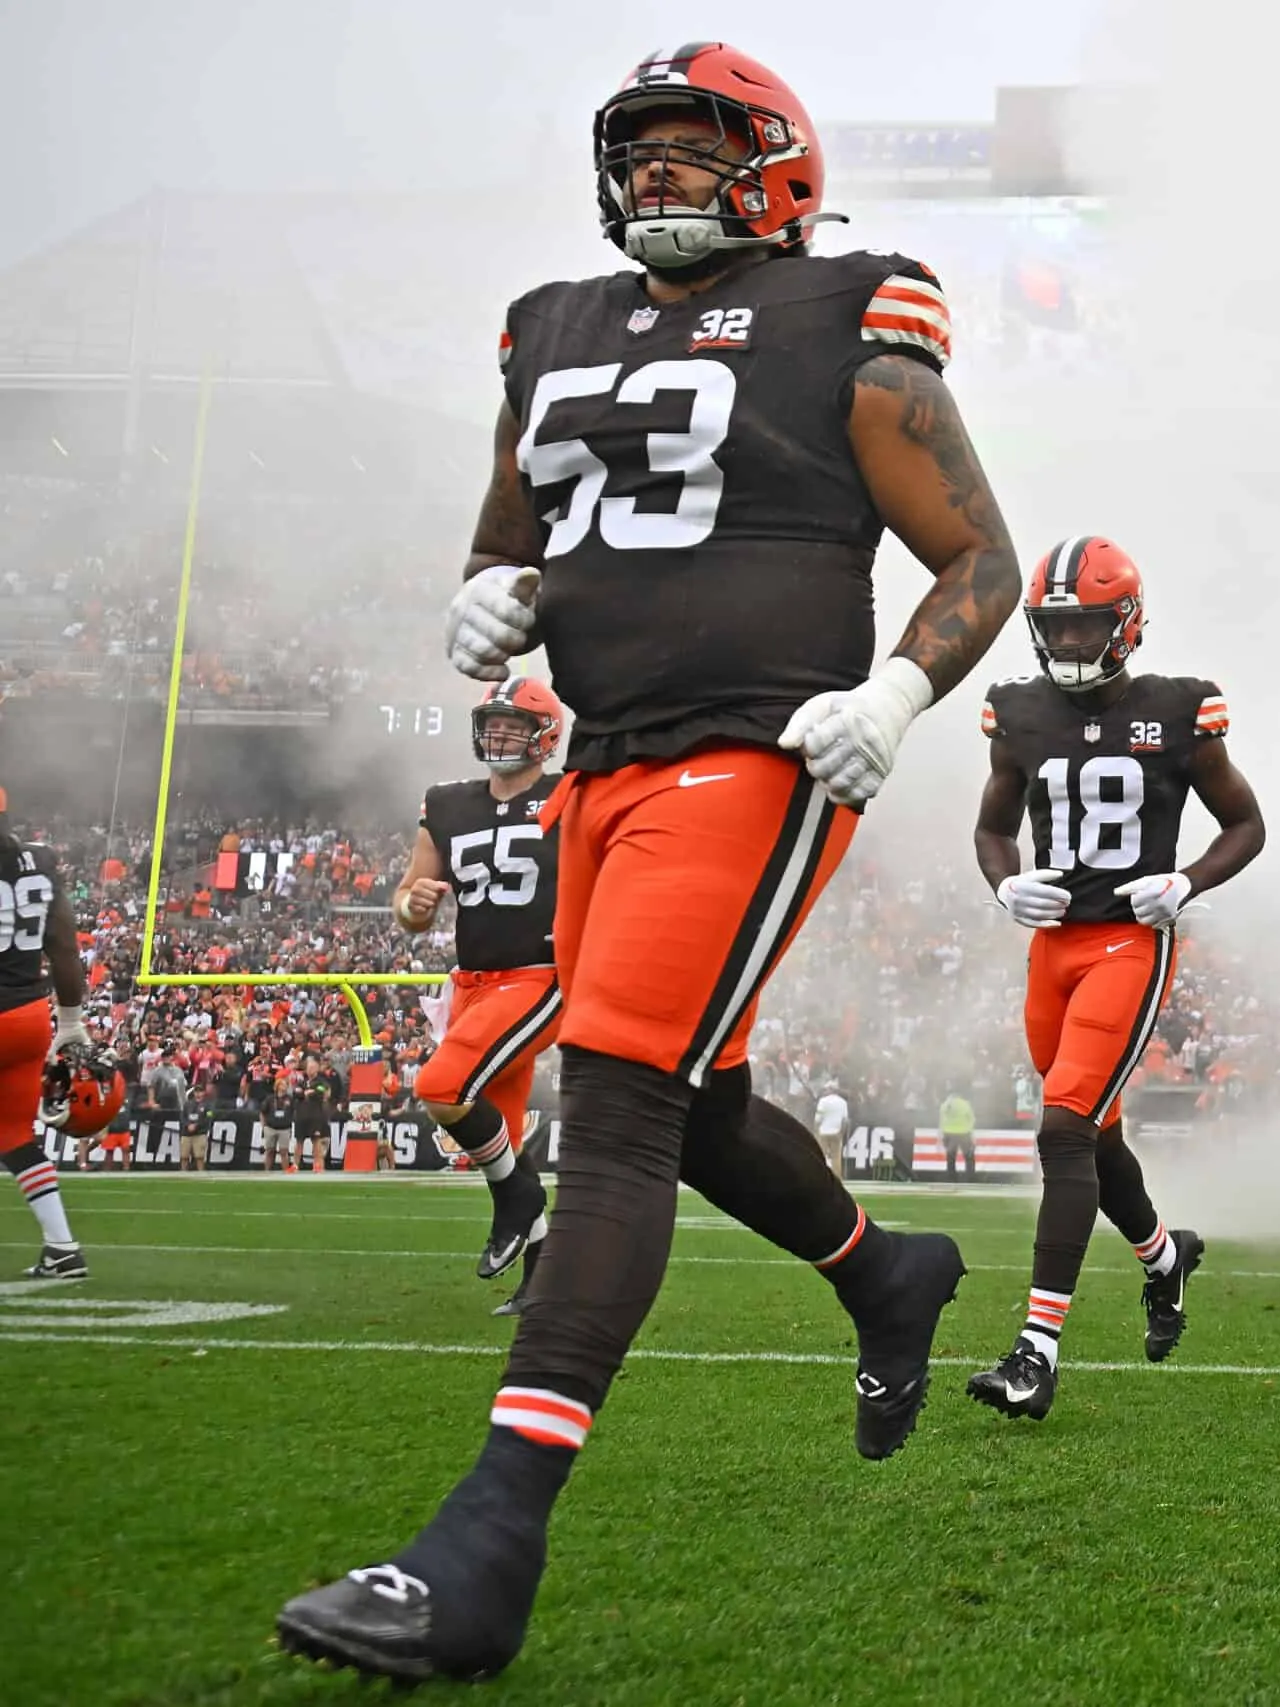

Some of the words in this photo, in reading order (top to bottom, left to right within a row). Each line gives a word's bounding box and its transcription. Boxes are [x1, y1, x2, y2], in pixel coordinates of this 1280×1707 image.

[693, 308, 752, 341] 32
[516, 359, 737, 560] 53
[380, 706, 443, 735] 7:13
[1130, 721, 1162, 745] 32
[1038, 756, 1145, 870] 18
[450, 824, 544, 907] 55
